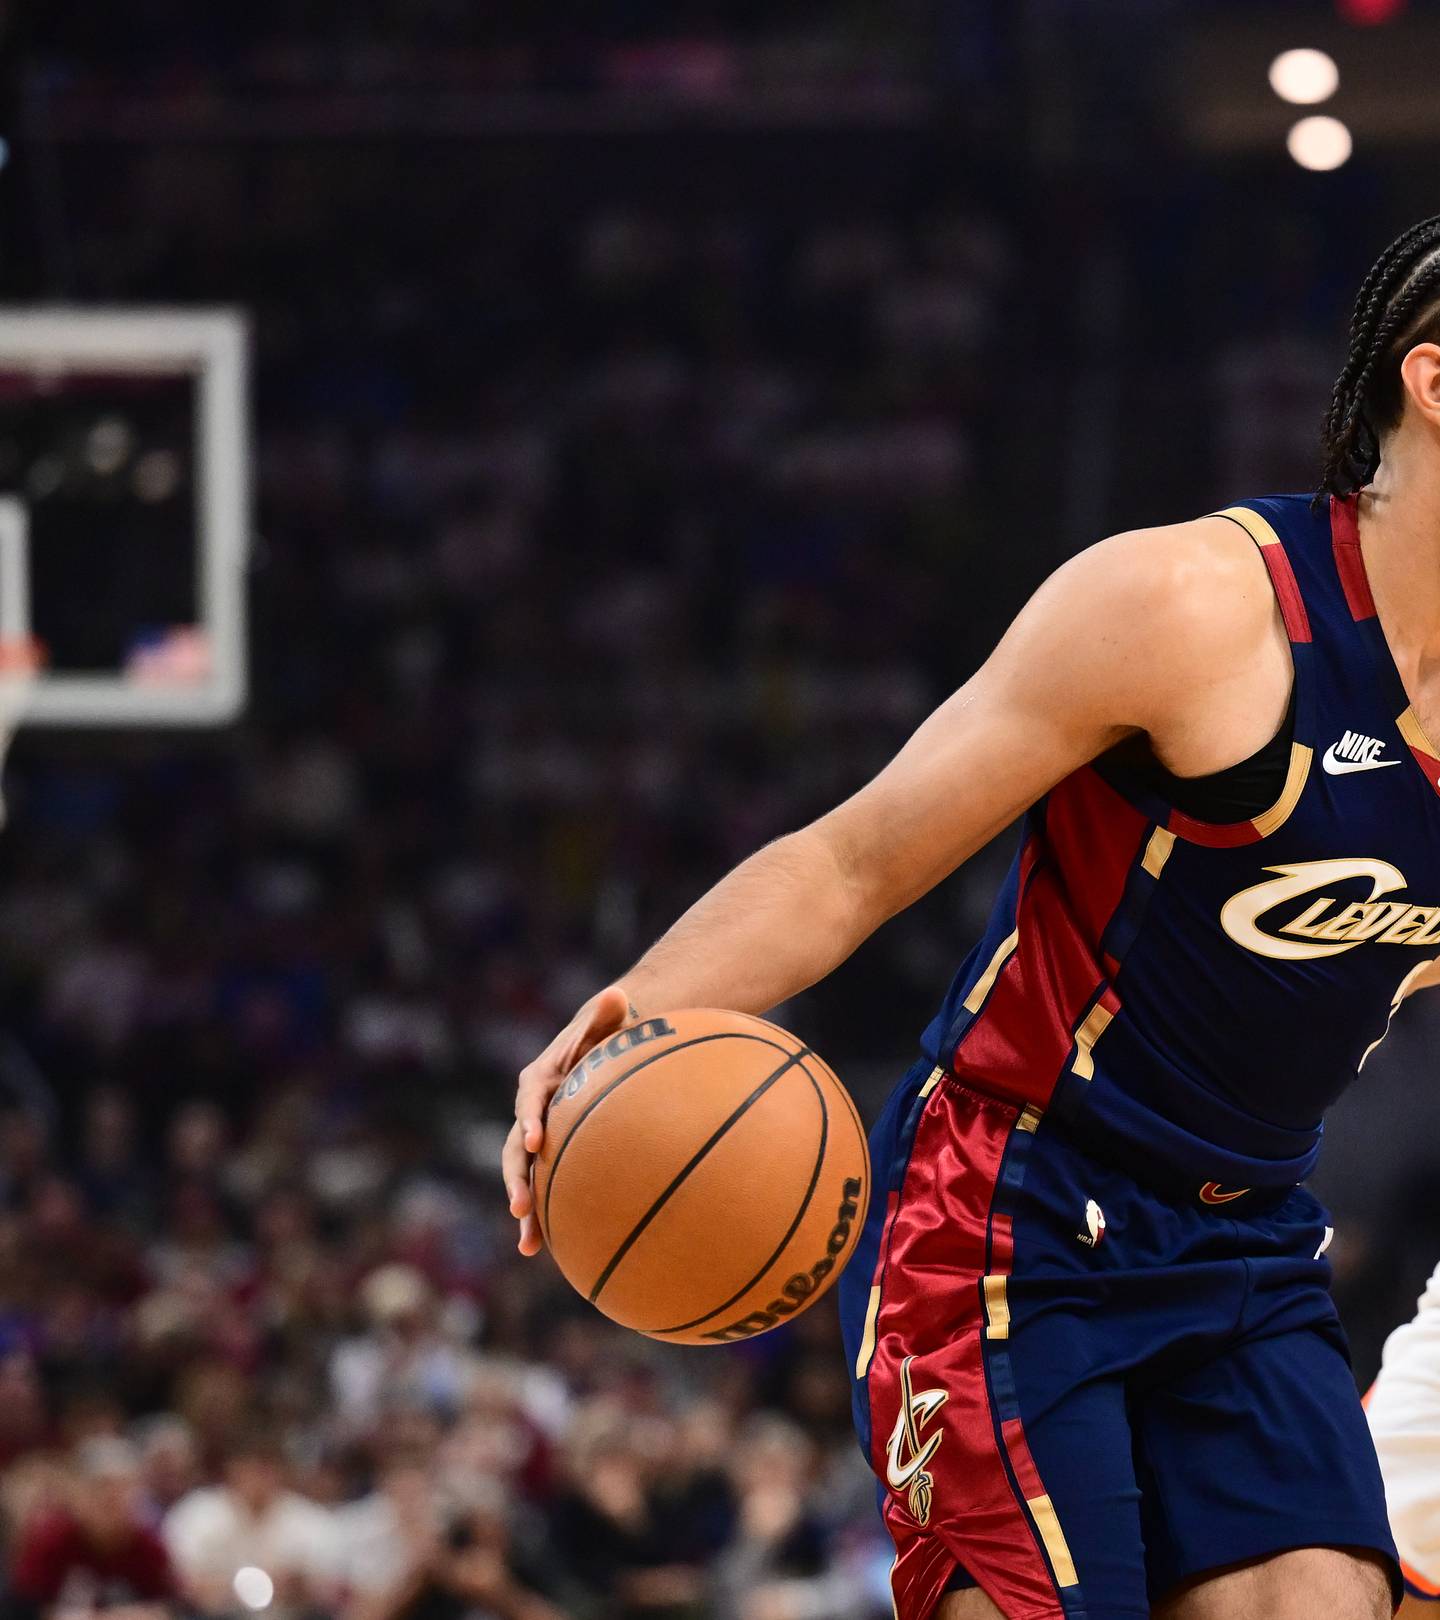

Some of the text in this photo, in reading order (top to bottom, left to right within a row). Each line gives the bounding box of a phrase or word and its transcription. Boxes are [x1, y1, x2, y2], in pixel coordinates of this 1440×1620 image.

[1335, 730, 1386, 763] NIKE
[1076, 1233, 1093, 1246] NBA
[700, 1176, 862, 1341] Wilson
